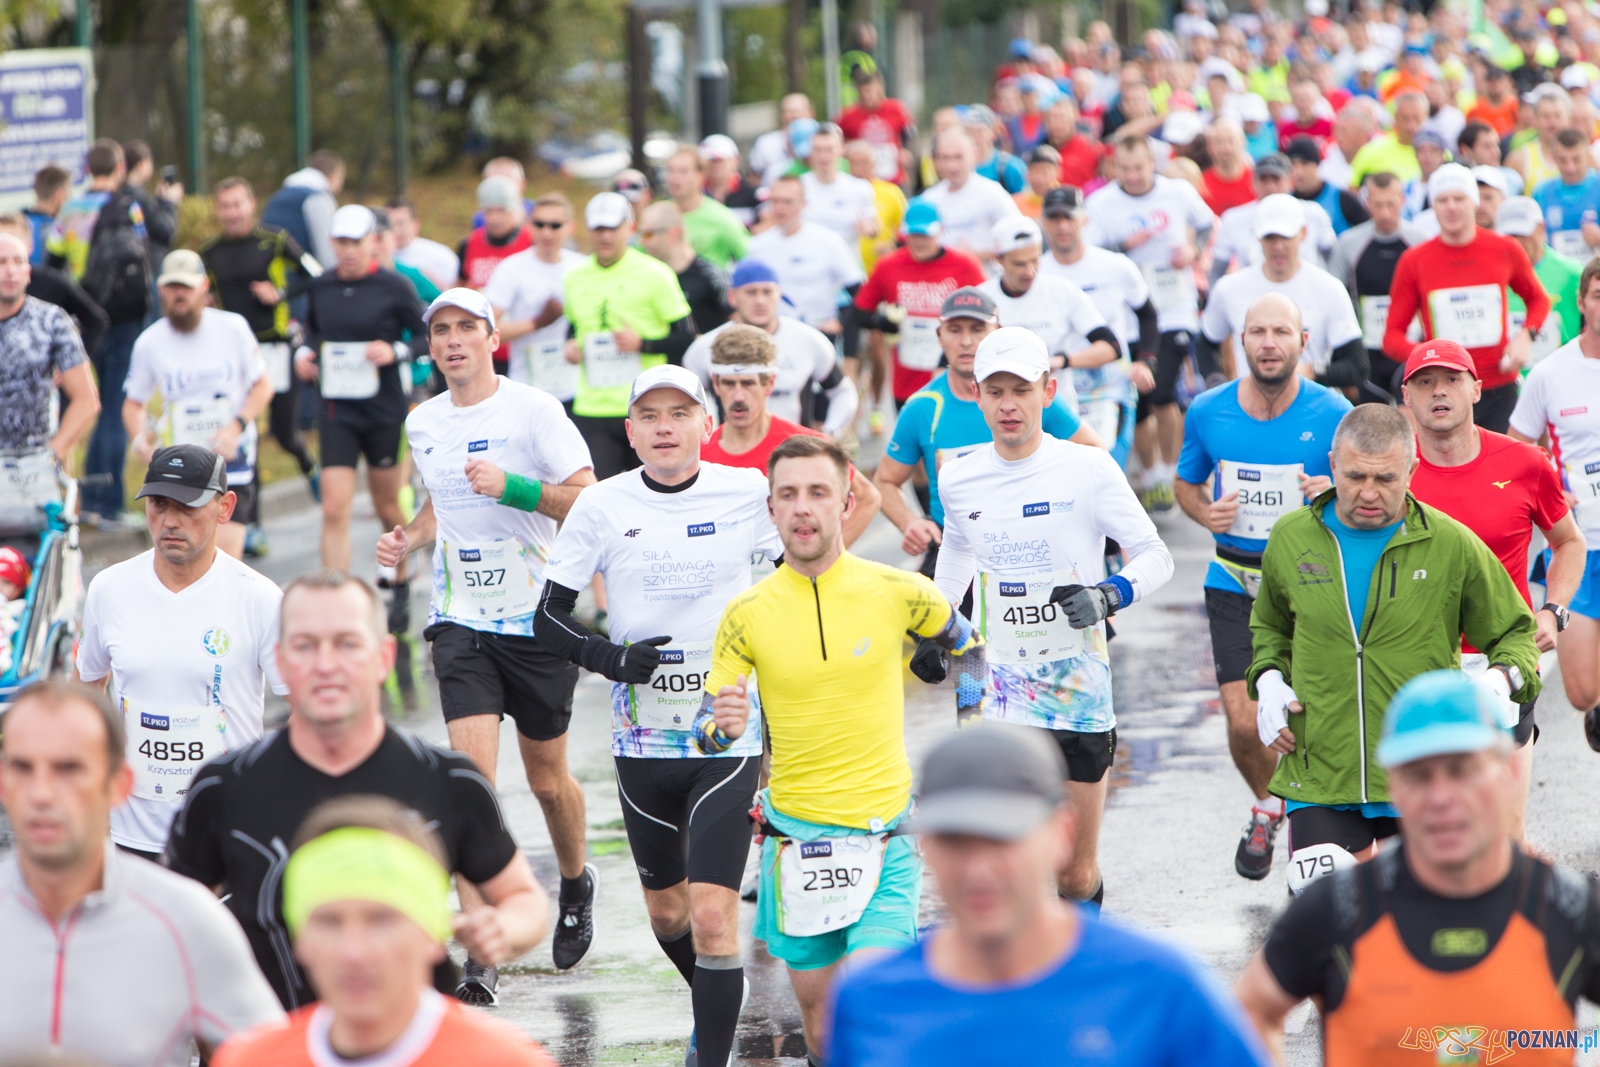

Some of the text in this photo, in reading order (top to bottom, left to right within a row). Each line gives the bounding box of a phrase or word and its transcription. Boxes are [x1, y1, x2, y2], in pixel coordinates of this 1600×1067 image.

[1238, 489, 1283, 506] 3461
[1242, 509, 1279, 517] Arkadiusz
[624, 528, 641, 537] 4F
[983, 532, 1009, 543] SIŁA
[993, 539, 1049, 554] ODWAGA
[642, 550, 672, 561] SIŁA
[989, 550, 1051, 566] SZYBKOŚĆ
[651, 559, 714, 573] ODWAGA
[464, 568, 506, 587] 5127
[643, 570, 714, 586] SZYBKOŚĆ
[471, 589, 506, 599] Krzysztof
[1003, 603, 1057, 625] 4130
[1015, 629, 1047, 638] Stachu
[138, 739, 204, 761] 4858
[147, 764, 193, 776] Krzysztof
[803, 867, 863, 891] 2390
